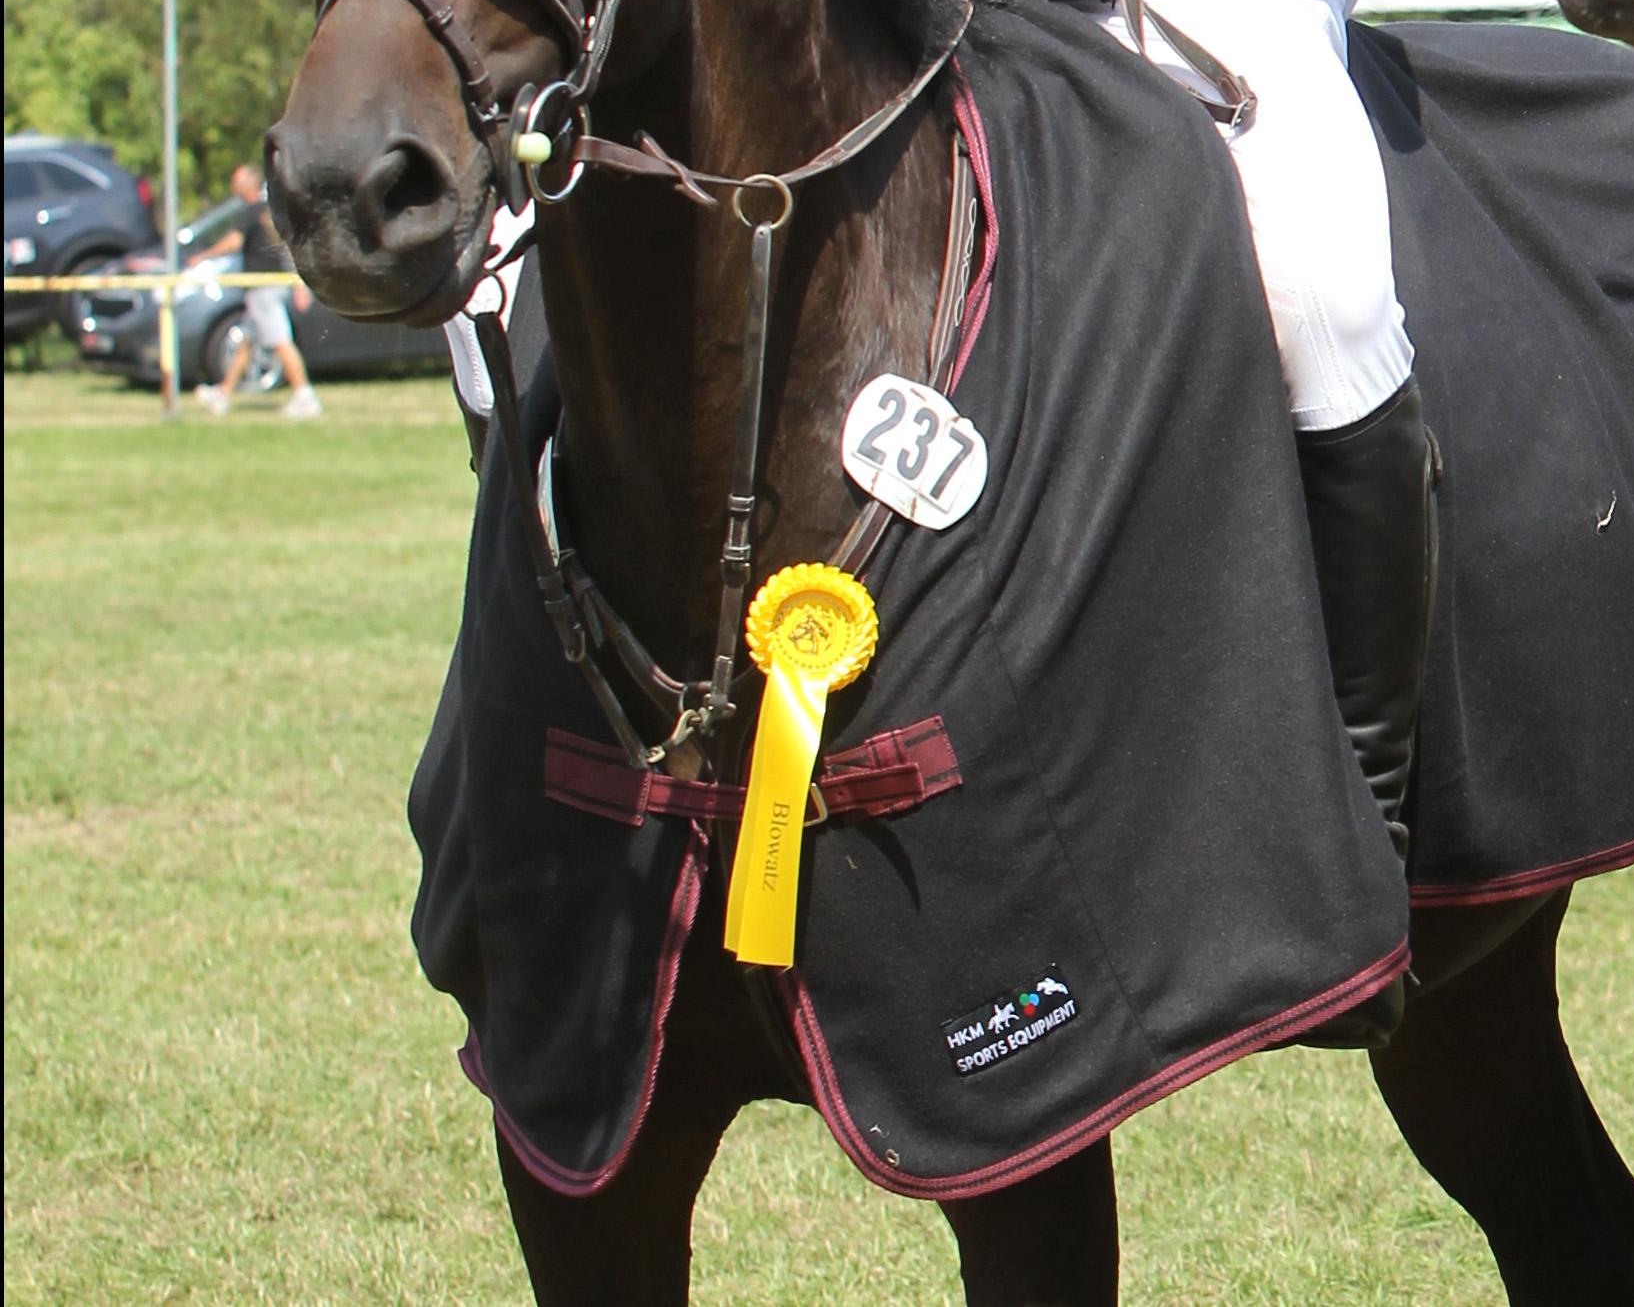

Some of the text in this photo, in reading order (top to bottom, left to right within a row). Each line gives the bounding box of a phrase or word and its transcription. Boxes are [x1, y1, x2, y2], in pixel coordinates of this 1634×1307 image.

[856, 388, 975, 501] 237
[763, 802, 790, 892] Blowatz
[947, 1022, 985, 1049] HKM
[956, 999, 1076, 1073] SPORTS EQUIPMENT
